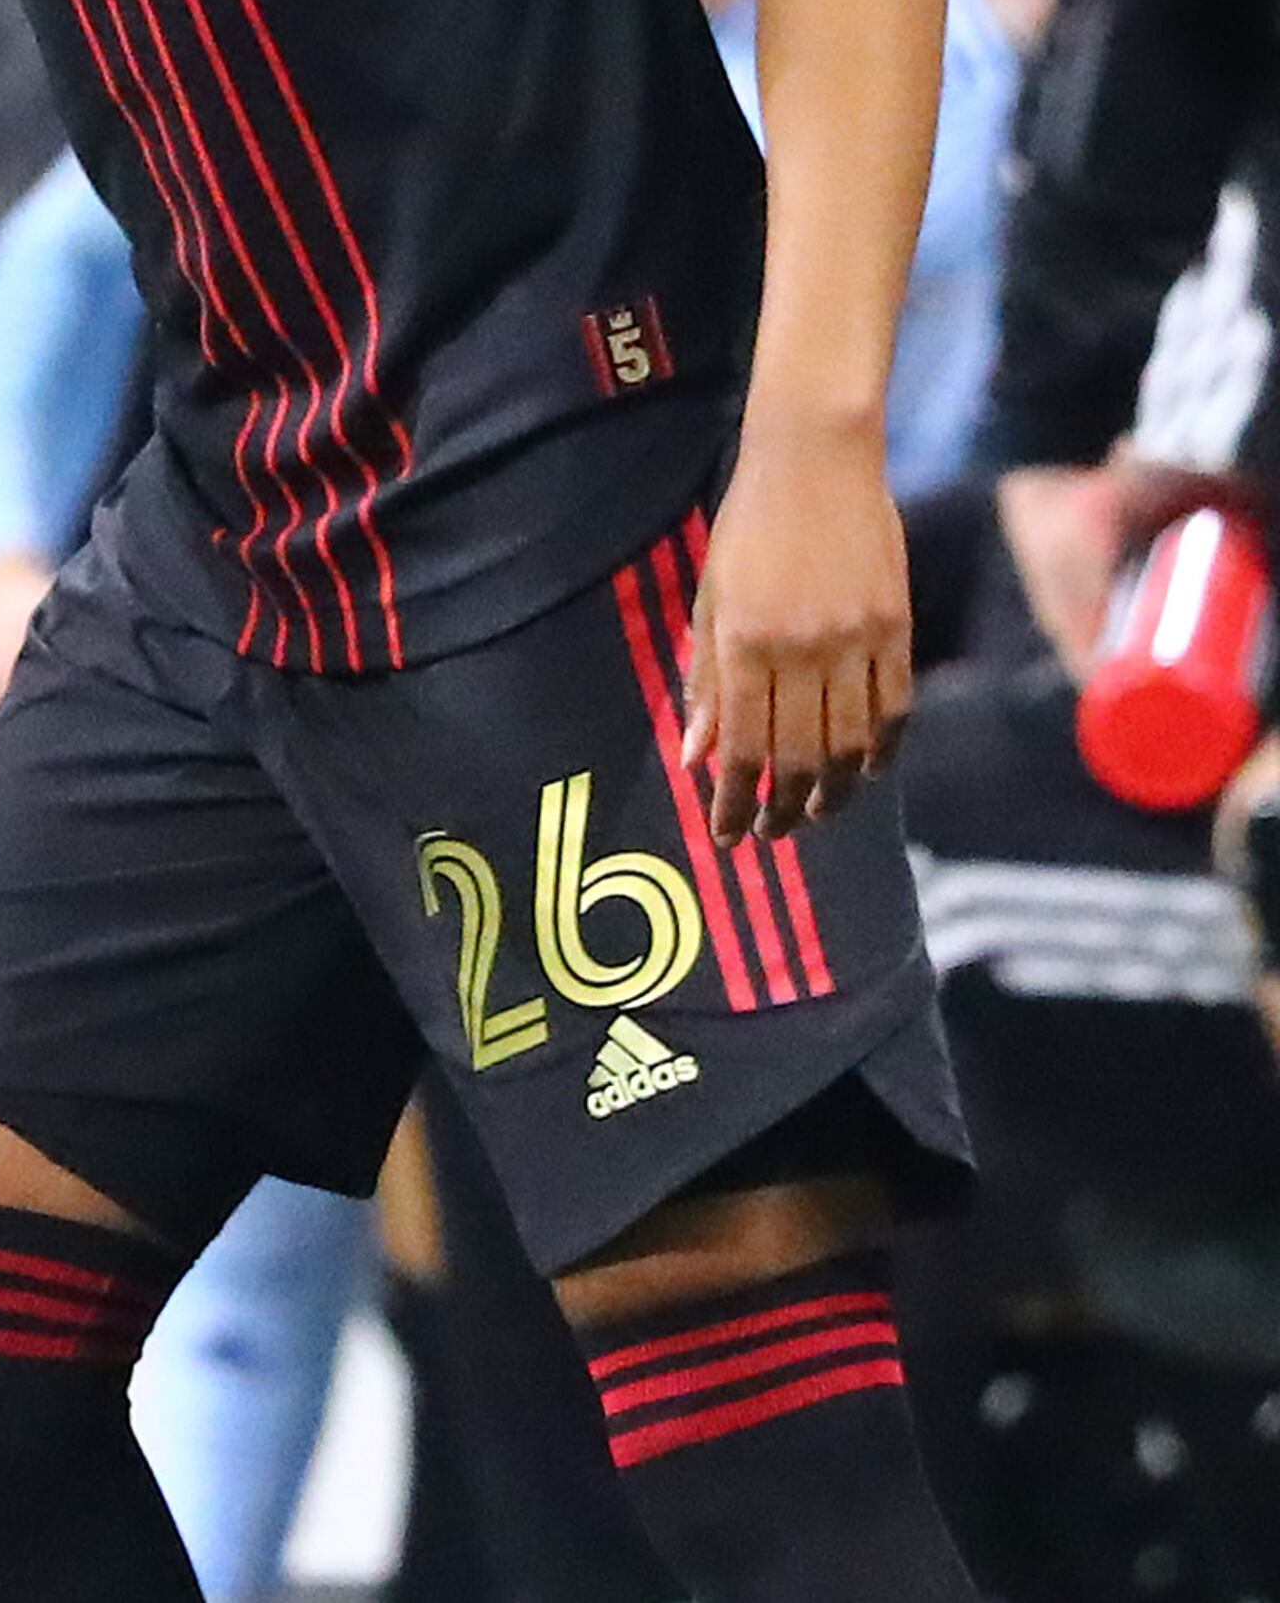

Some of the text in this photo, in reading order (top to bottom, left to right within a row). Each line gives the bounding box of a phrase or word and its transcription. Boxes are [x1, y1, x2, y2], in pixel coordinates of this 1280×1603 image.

[606, 326, 652, 384] 5
[414, 770, 704, 1072] 26
[586, 1053, 700, 1120] adidas
